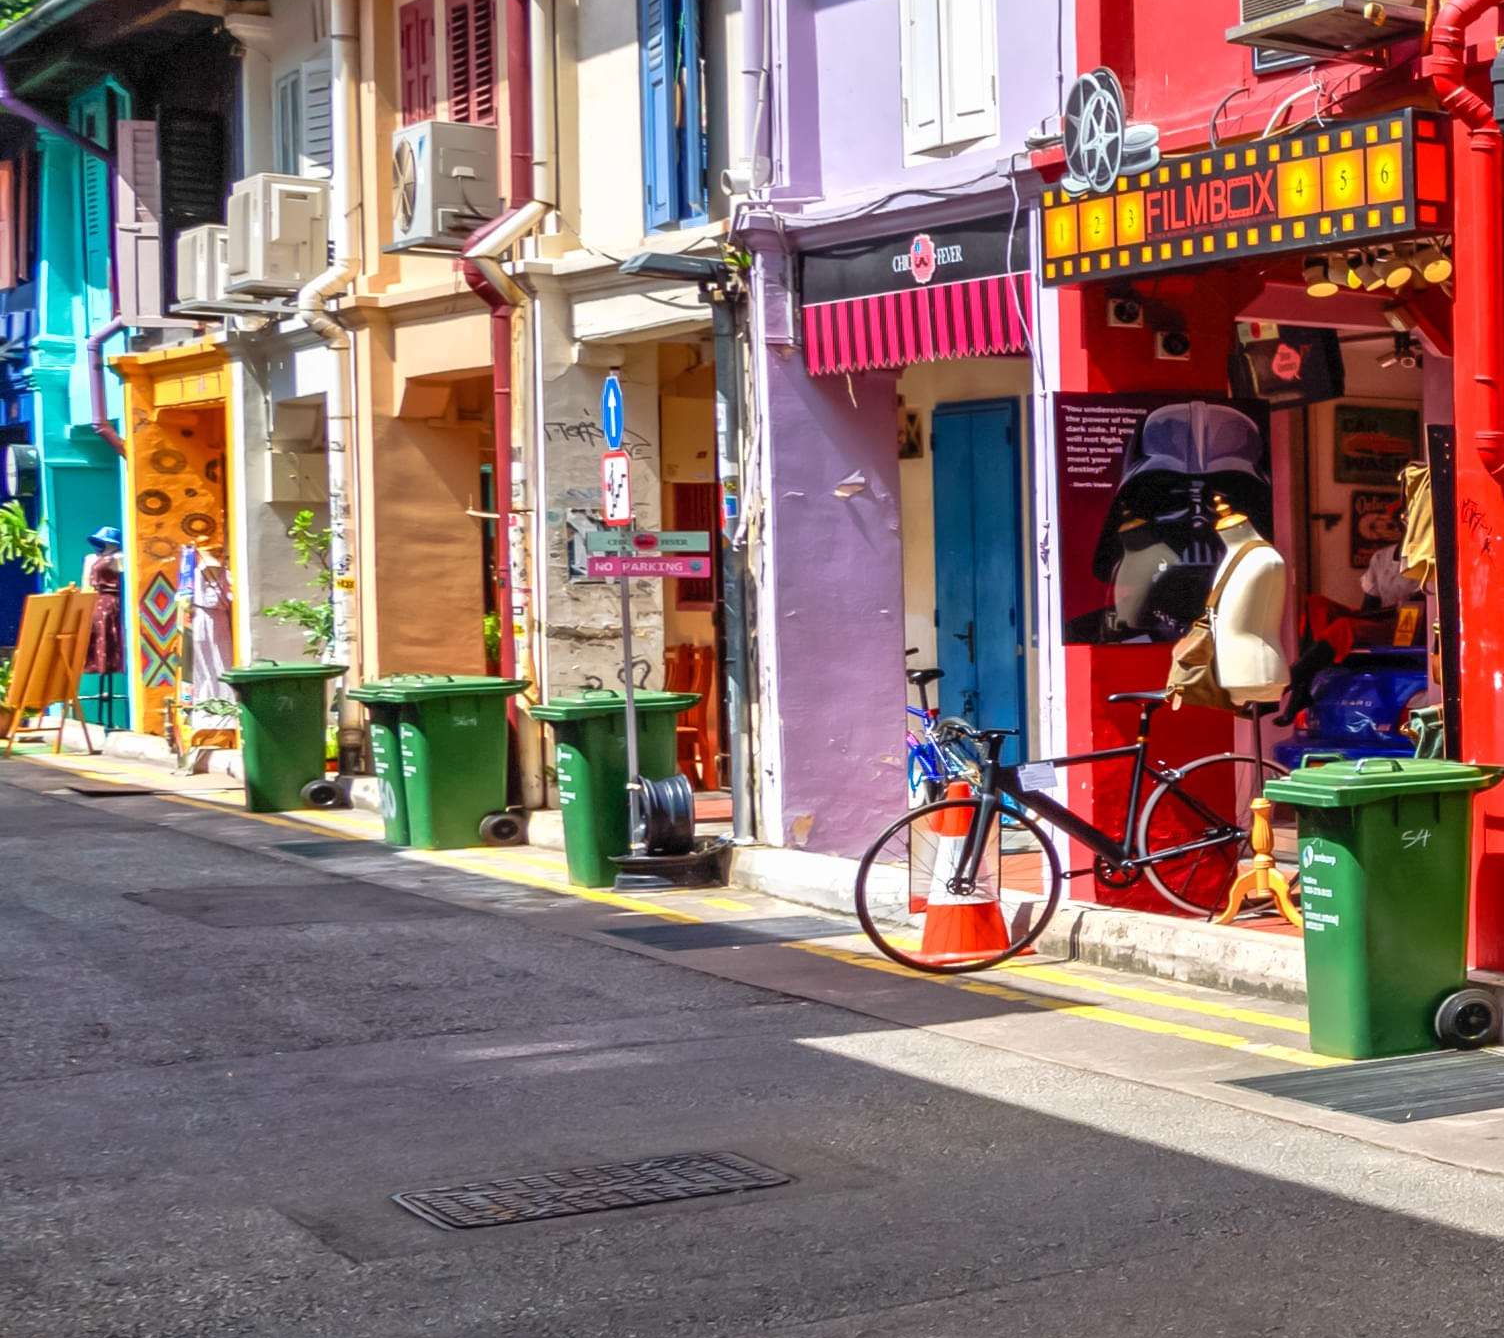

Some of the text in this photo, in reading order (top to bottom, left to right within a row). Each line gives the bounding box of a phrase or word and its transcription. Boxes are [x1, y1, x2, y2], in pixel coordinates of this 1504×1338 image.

[1092, 215, 1101, 235] 2
[1146, 169, 1275, 234] FILMBOX
[1294, 178, 1304, 199] 4
[1338, 169, 1349, 192] 5
[1379, 162, 1390, 185] 6
[937, 245, 964, 265] FEVER
[594, 561, 683, 572] NO PARKING
